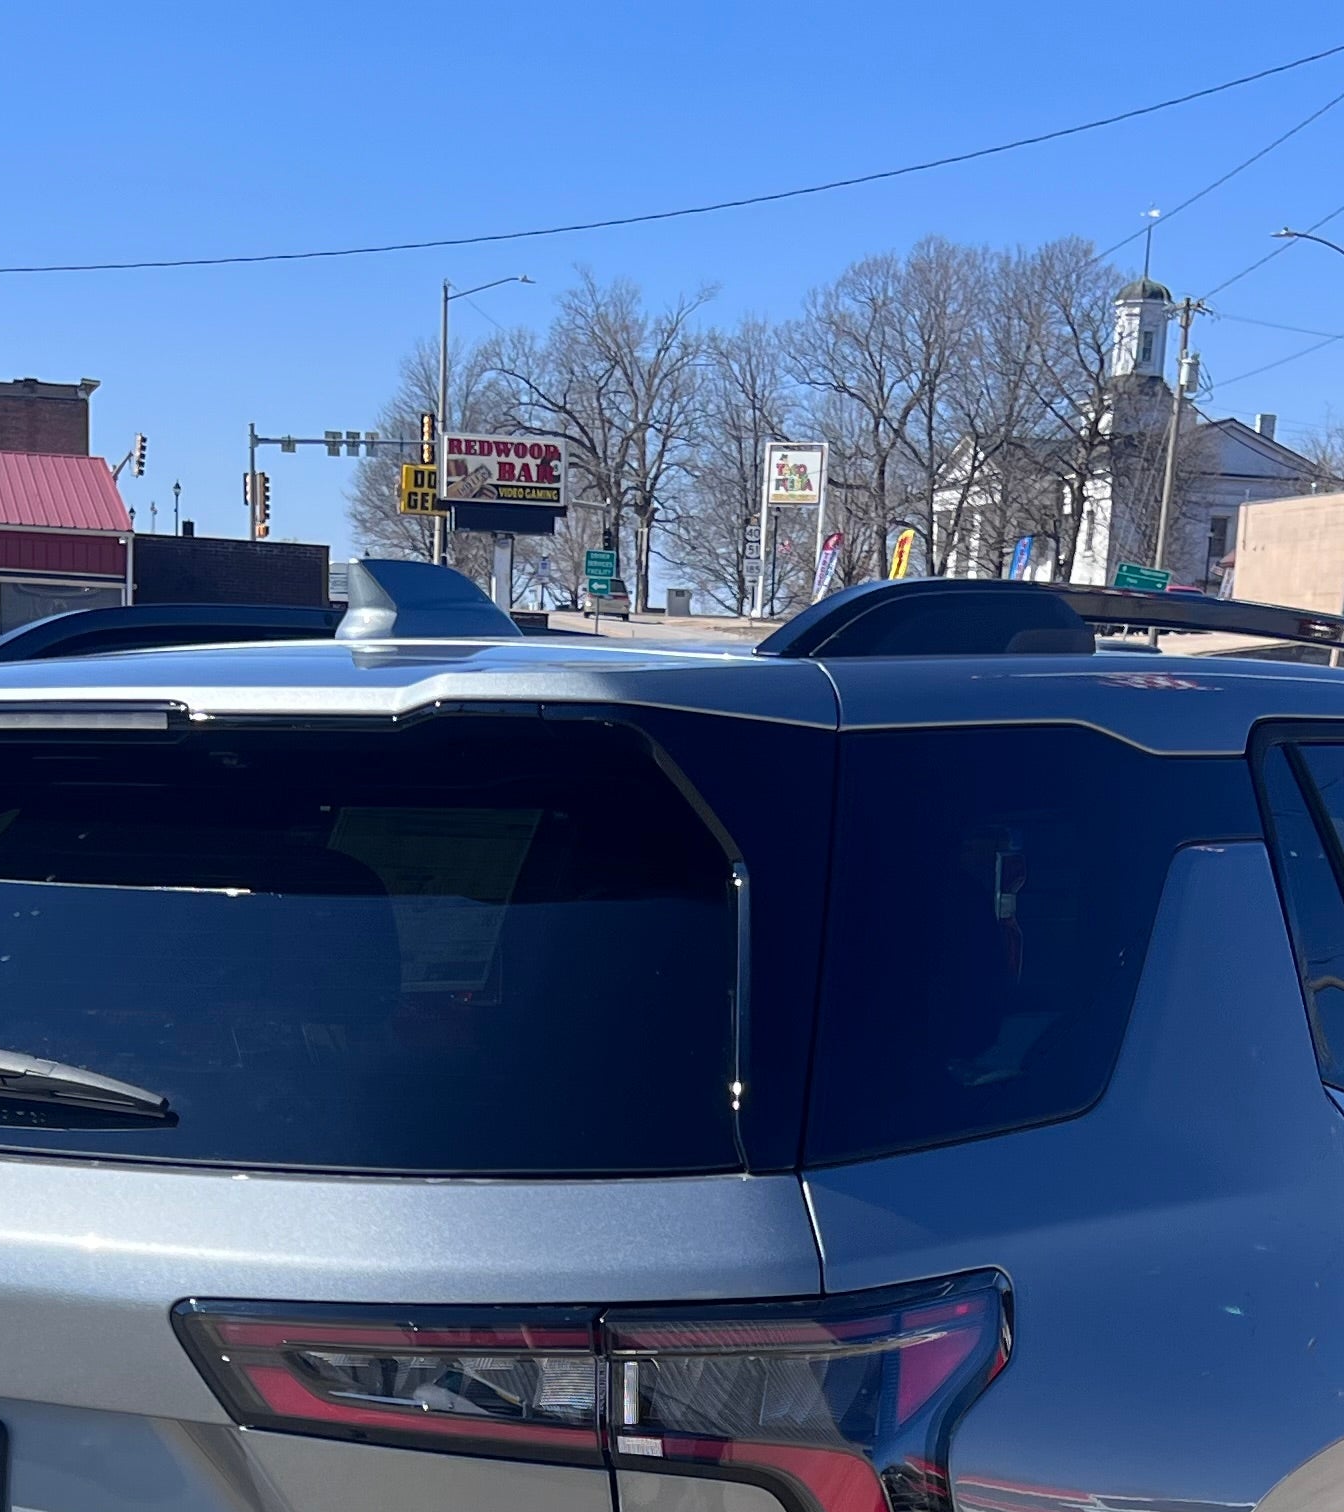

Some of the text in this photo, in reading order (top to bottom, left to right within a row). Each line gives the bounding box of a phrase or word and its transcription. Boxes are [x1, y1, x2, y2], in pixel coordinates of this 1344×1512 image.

[447, 437, 561, 460] REDWOOD
[497, 461, 555, 484] BAR
[498, 486, 559, 500] VIDEO GAMING
[746, 528, 760, 539] 40
